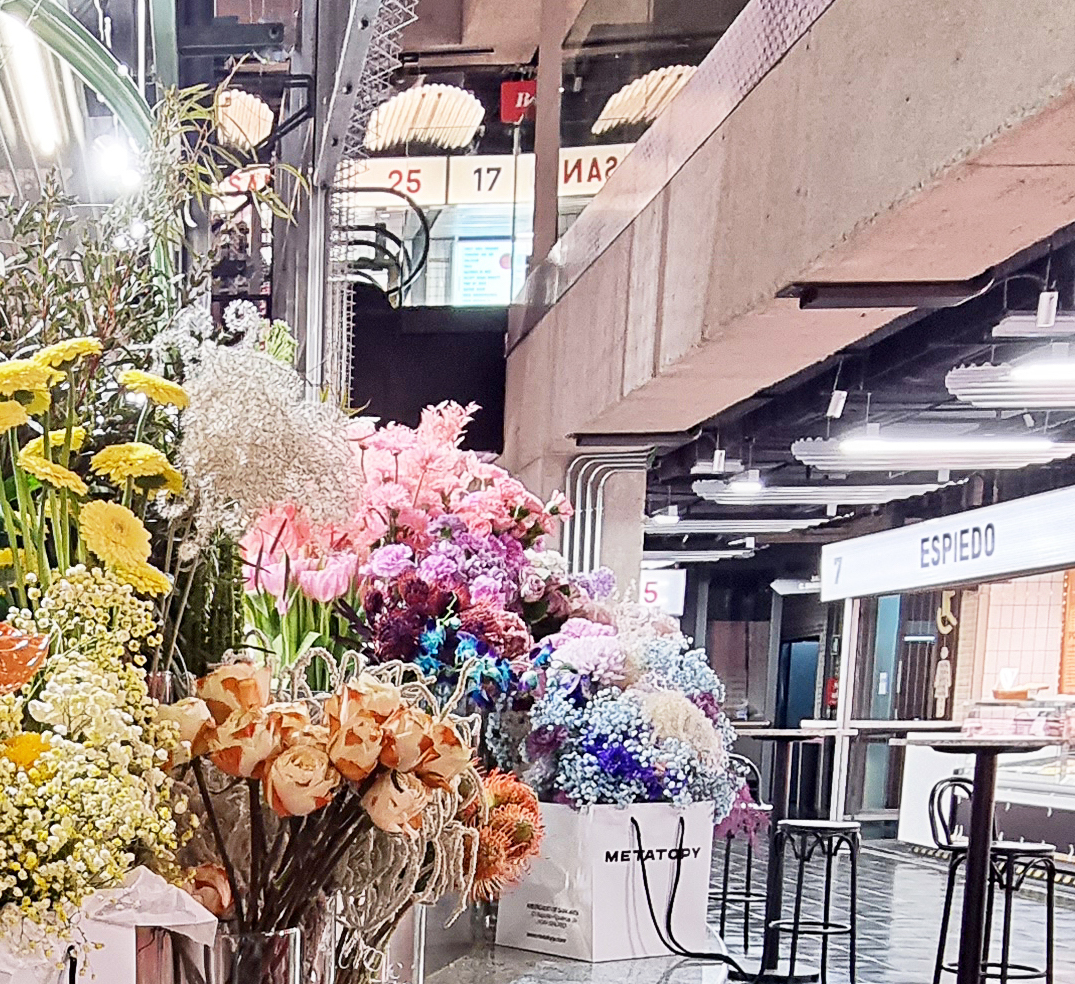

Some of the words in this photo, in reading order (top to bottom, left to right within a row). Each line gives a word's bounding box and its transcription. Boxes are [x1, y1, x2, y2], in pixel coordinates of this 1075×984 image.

[388, 169, 422, 193] 25
[473, 167, 502, 191] 17
[920, 522, 996, 569] ESPIEDO
[833, 557, 843, 585] 7
[643, 581, 658, 603] 5
[605, 847, 701, 862] METATOPY
